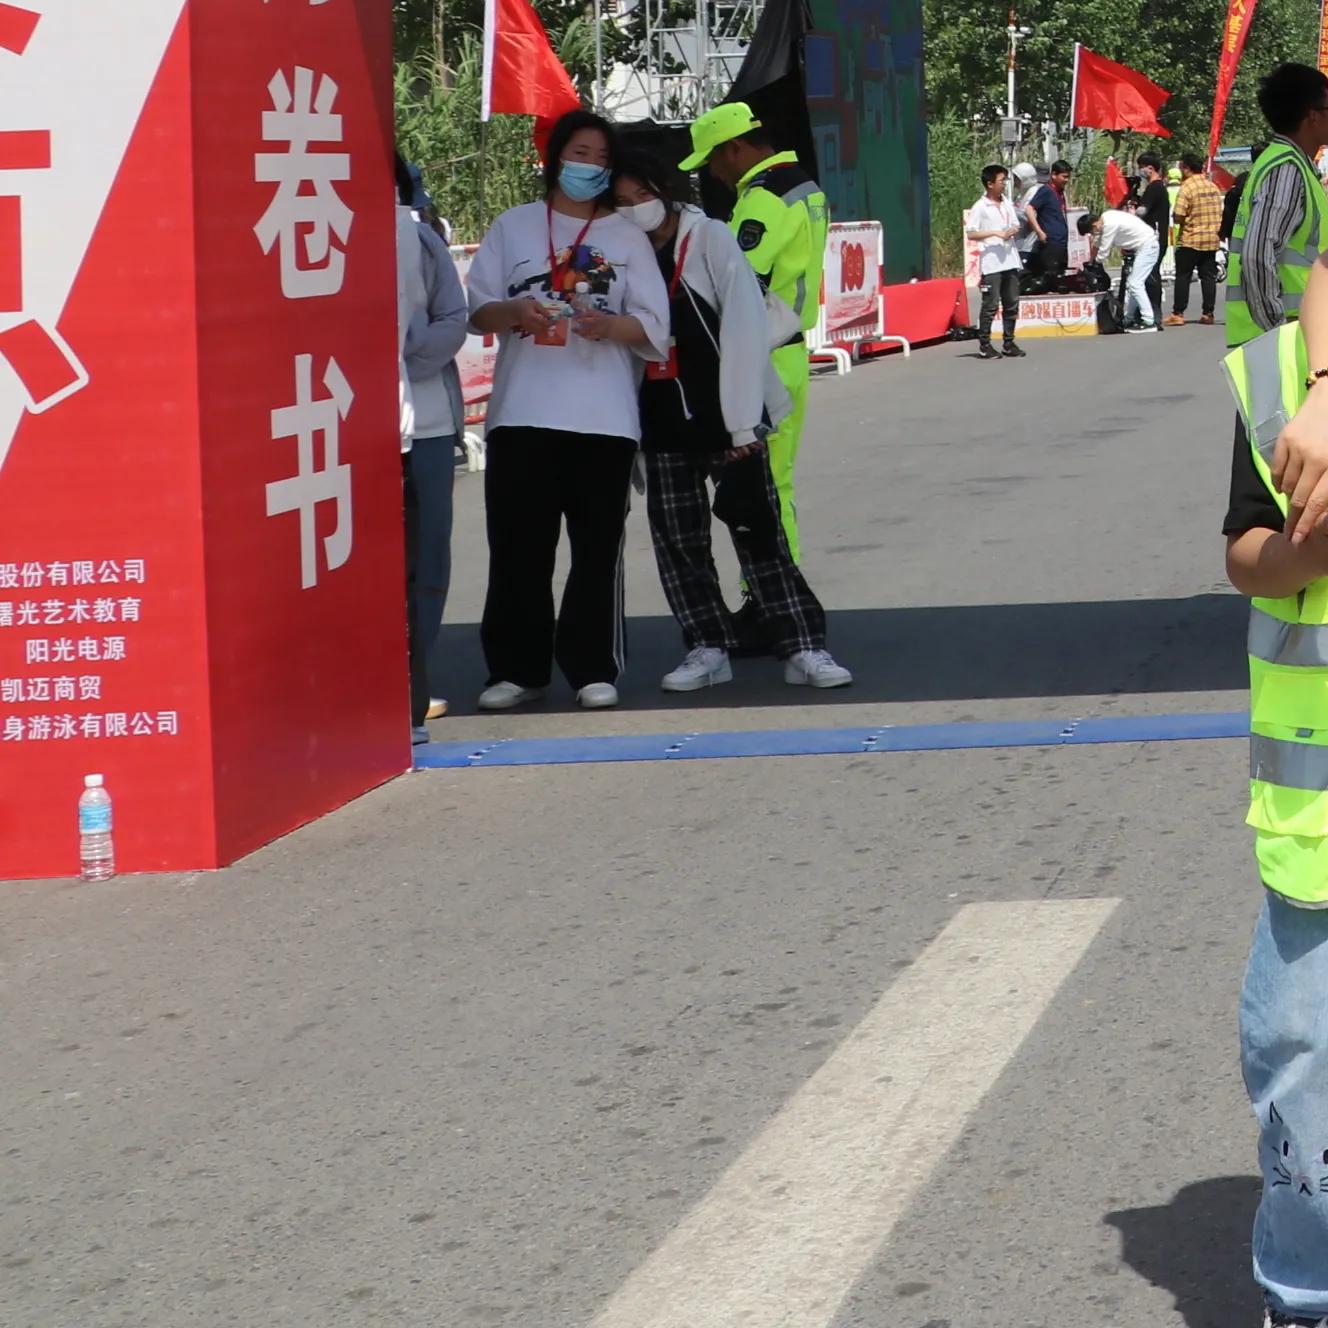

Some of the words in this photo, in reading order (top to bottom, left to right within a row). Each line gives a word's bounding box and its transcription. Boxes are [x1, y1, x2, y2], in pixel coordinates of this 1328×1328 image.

[26, 635, 127, 665] 阳光电源
[0, 675, 102, 704] 凯迈商贸
[2, 710, 179, 742] 身游泳有限公司
